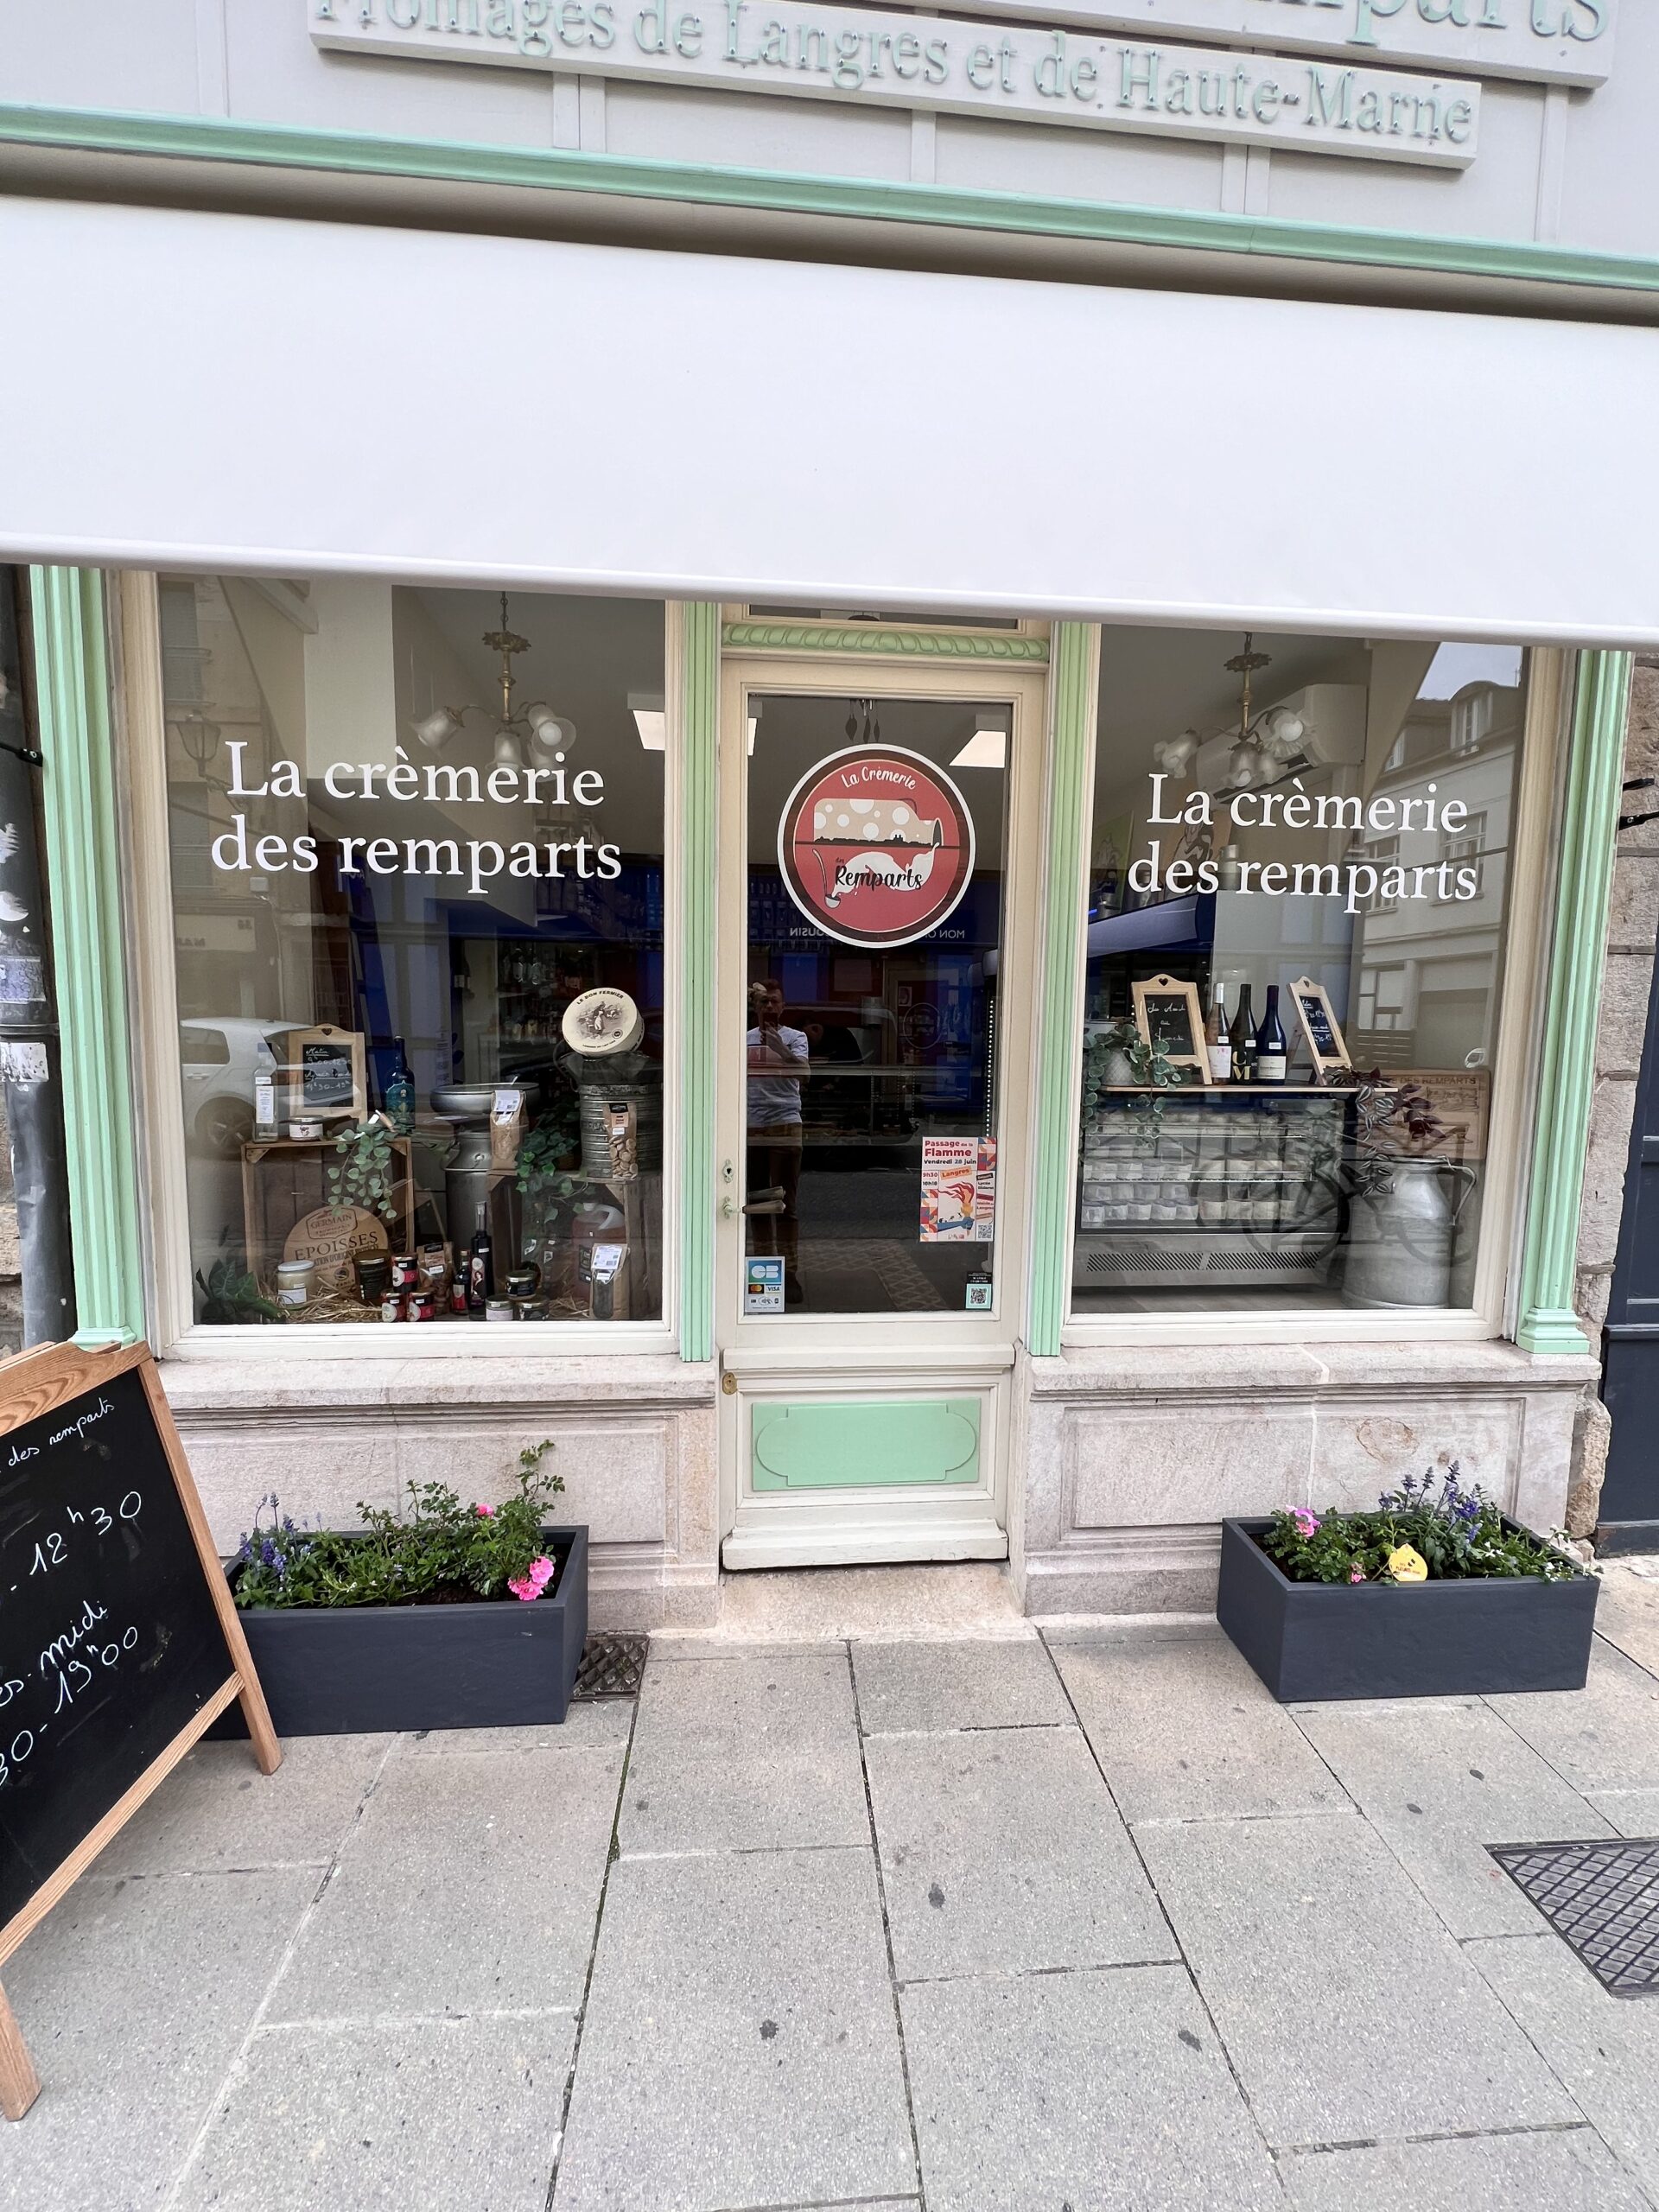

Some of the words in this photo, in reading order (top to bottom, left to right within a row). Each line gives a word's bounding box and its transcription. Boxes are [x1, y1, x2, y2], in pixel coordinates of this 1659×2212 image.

[633, 0, 704, 57] de
[720, 0, 950, 89] Langres
[967, 36, 1018, 92] et
[1033, 30, 1099, 100] de
[1117, 47, 1472, 143] Haute-Marne
[225, 741, 307, 798] La
[324, 745, 606, 807] crèmerie
[841, 773, 860, 788] La
[1147, 773, 1214, 827] La
[1230, 778, 1469, 833] crèmerie
[211, 814, 319, 873] des
[337, 834, 623, 894] remparts
[835, 865, 923, 892] Remparts
[1128, 840, 1219, 895] des
[1235, 860, 1478, 914] remparts
[599, 990, 624, 999] FERMIER
[942, 1168, 969, 1178] Langres
[295, 1231, 378, 1261] EPOISSES
[8, 1446, 40, 1466] des
[49, 1397, 115, 1445] remparts
